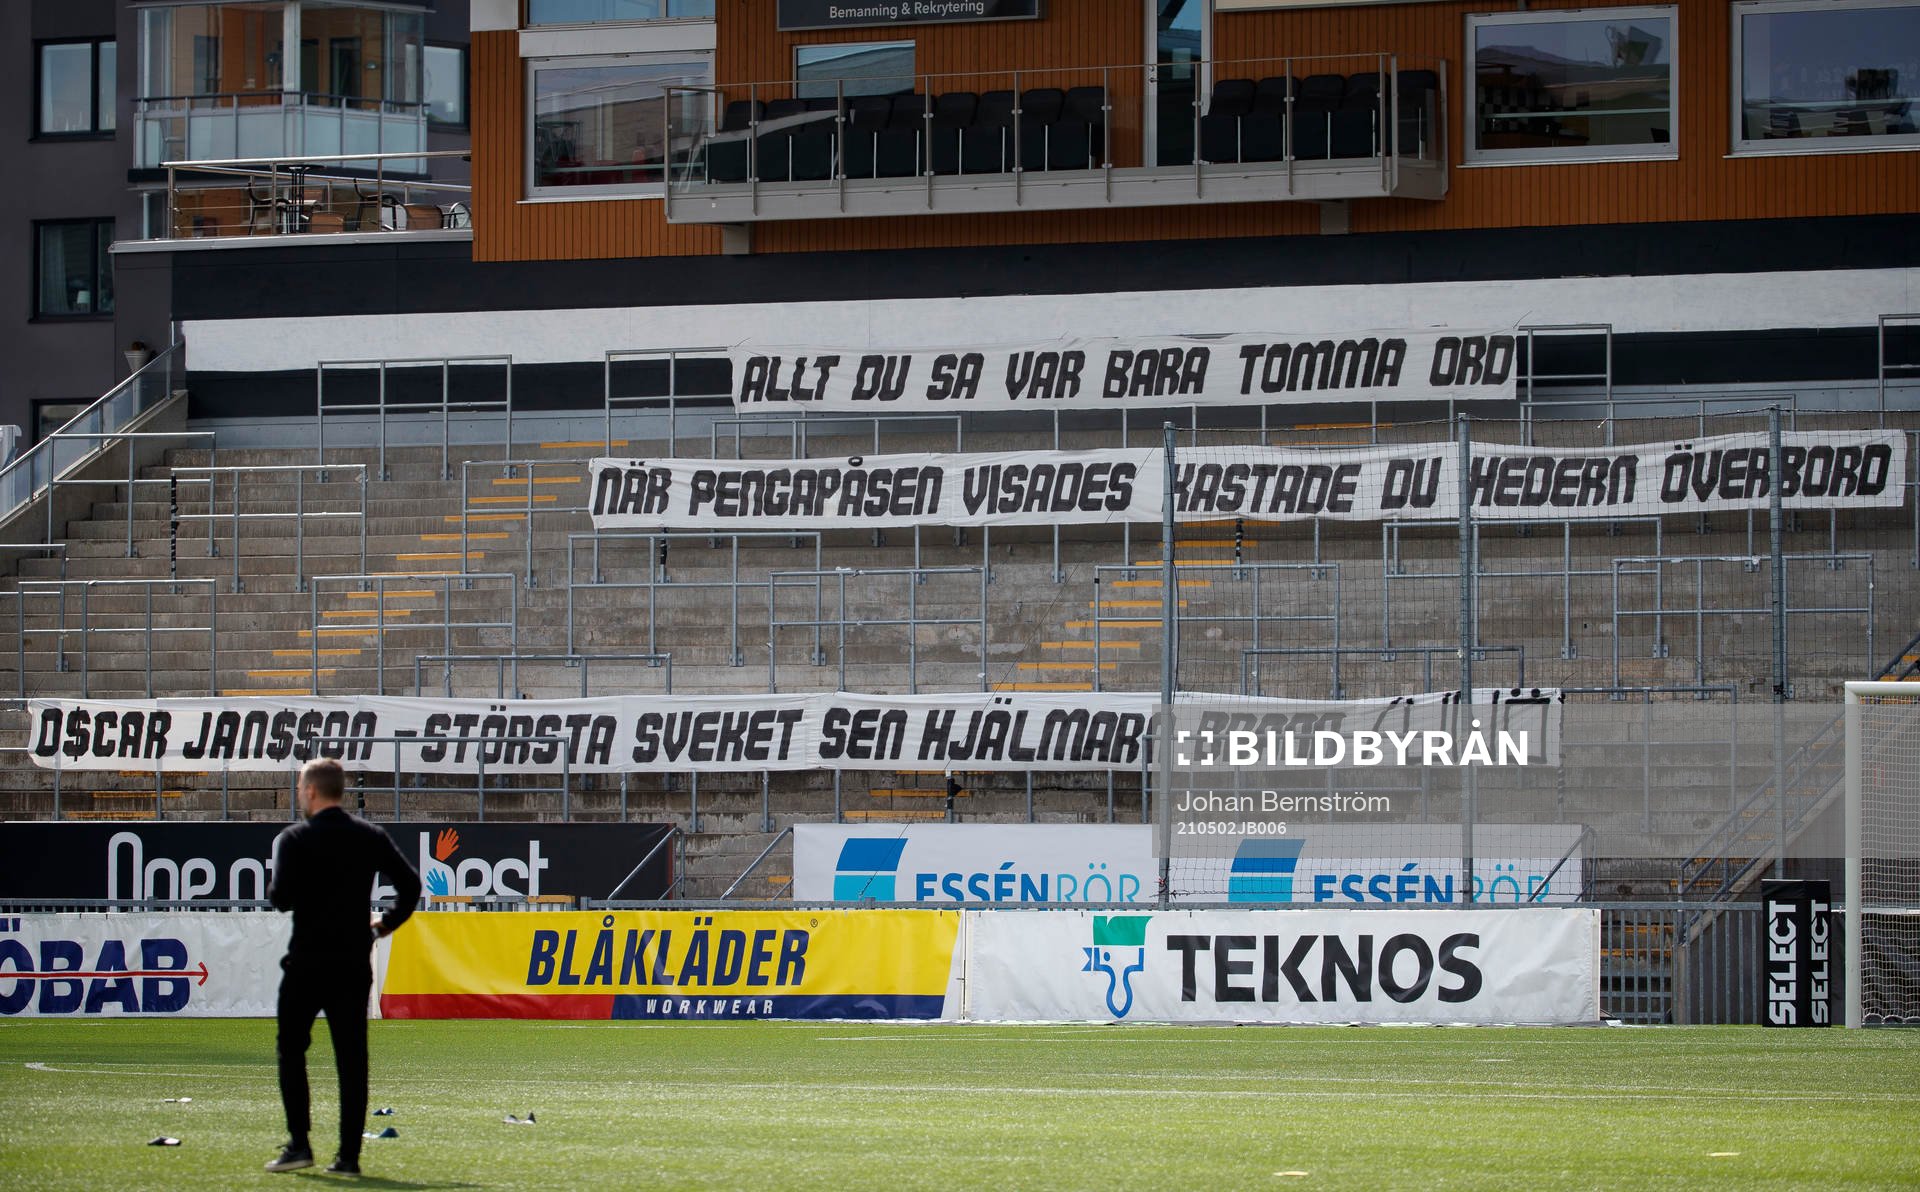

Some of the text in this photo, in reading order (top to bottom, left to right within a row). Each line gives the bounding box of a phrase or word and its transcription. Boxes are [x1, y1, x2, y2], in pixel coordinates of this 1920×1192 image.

[829, 0, 985, 19] Bemanning & Rekrytering
[740, 334, 1516, 403] ALLT DU SA VAR BARA TOMMA ORD
[593, 443, 1893, 517] NÄR PENGAPÅSEN VISADES KASTADE DU HEDERN ÖVERBORD
[631, 708, 804, 764] SVEKET
[818, 707, 908, 761] SEN
[229, 832, 284, 911] o
[526, 915, 810, 986] BLÅKLÄDER
[1166, 933, 1483, 1004] TEKNOS
[1769, 900, 1797, 1025] SELECT
[1811, 899, 1829, 1024] SELECT
[646, 999, 774, 1015] WORKWEAR
